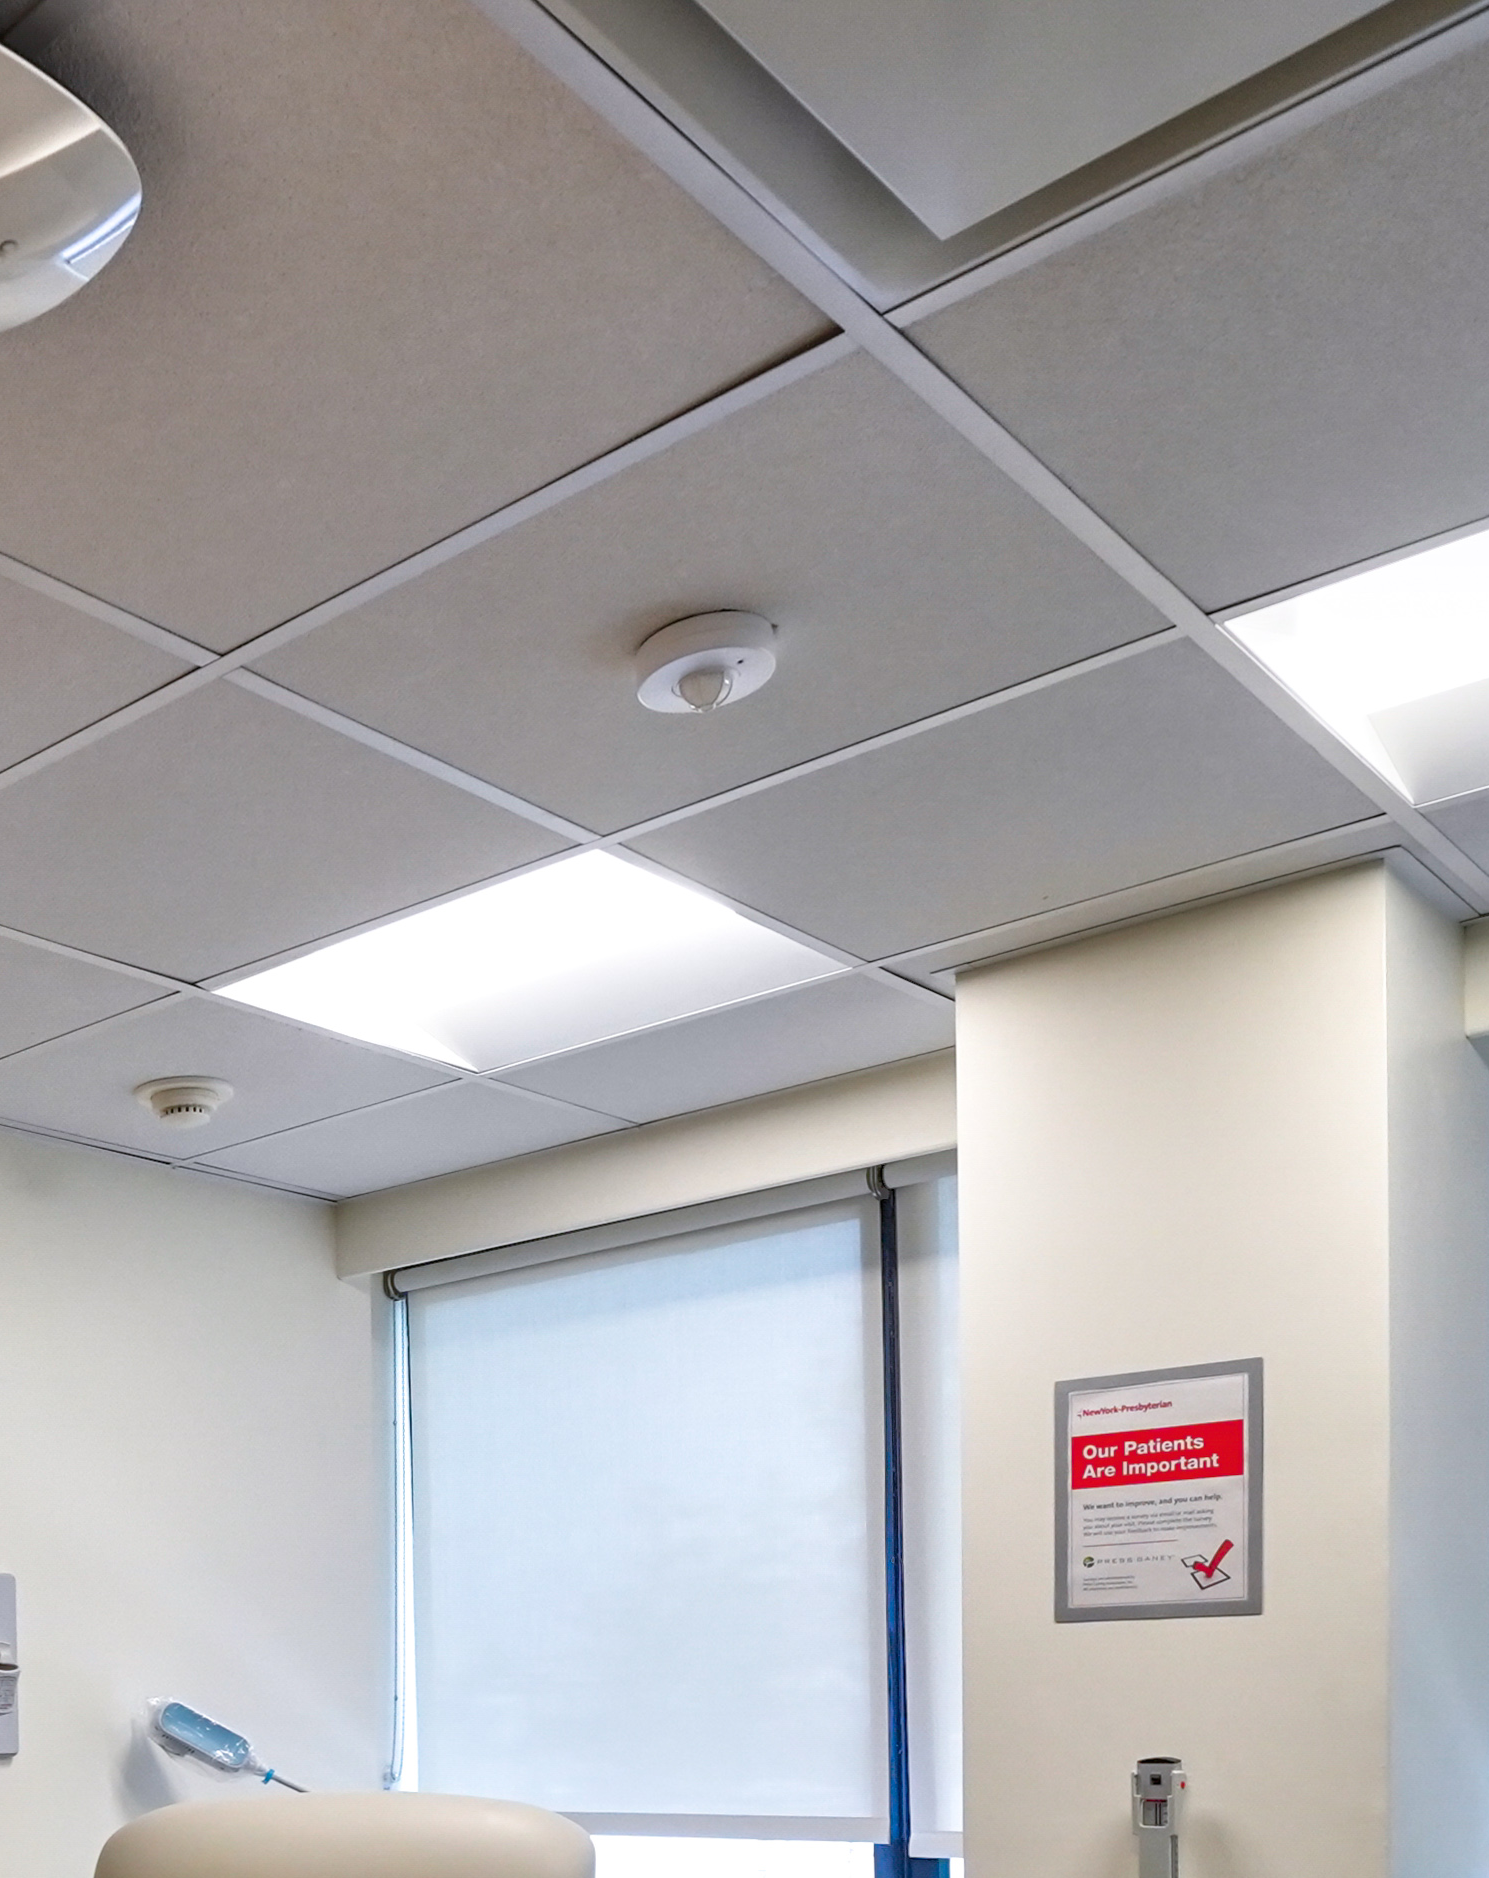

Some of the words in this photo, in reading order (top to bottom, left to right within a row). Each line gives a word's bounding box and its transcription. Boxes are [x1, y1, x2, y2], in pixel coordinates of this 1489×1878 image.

[1082, 1444, 1118, 1460] Our
[1124, 1435, 1204, 1456] Patients
[1082, 1464, 1116, 1479] Are
[1123, 1453, 1219, 1476] Important
